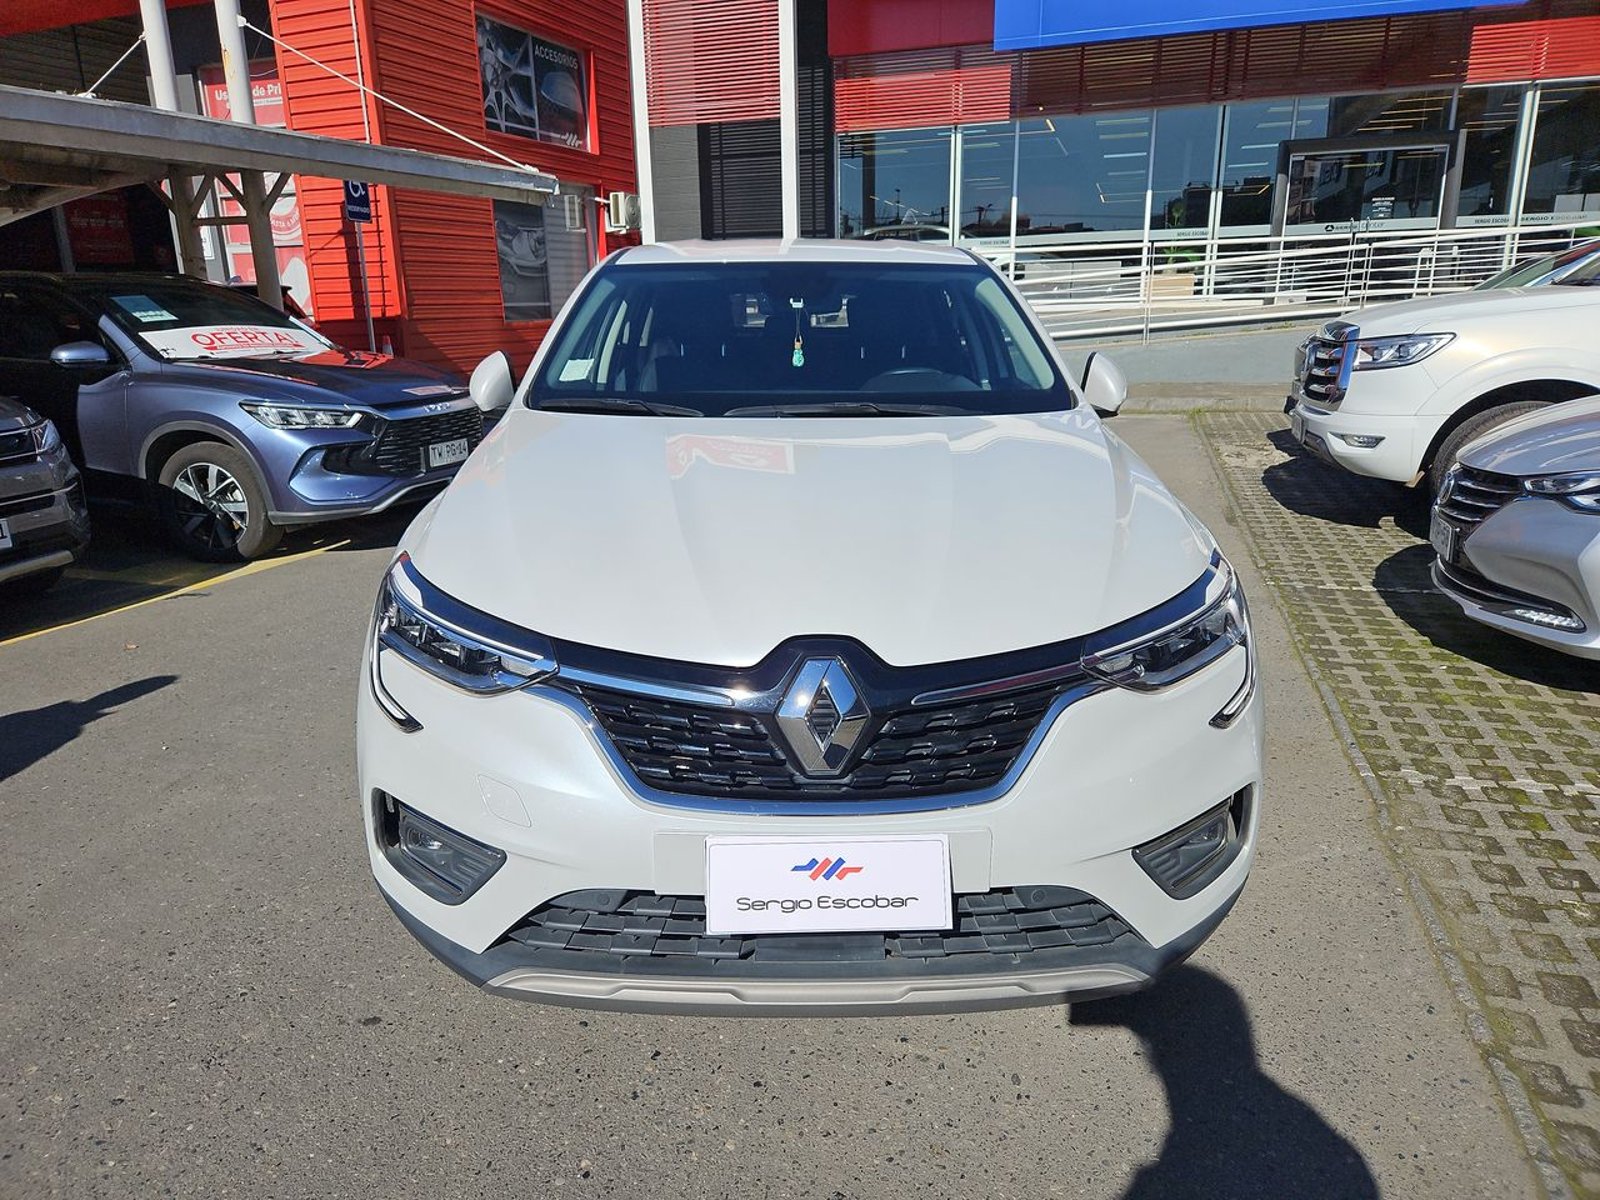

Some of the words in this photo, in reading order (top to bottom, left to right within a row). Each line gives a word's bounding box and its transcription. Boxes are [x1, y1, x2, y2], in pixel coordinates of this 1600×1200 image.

[534, 45, 579, 70] ACCESORIOS
[252, 85, 266, 97] de
[736, 896, 813, 913] Sergio
[816, 894, 919, 909] Escobar
